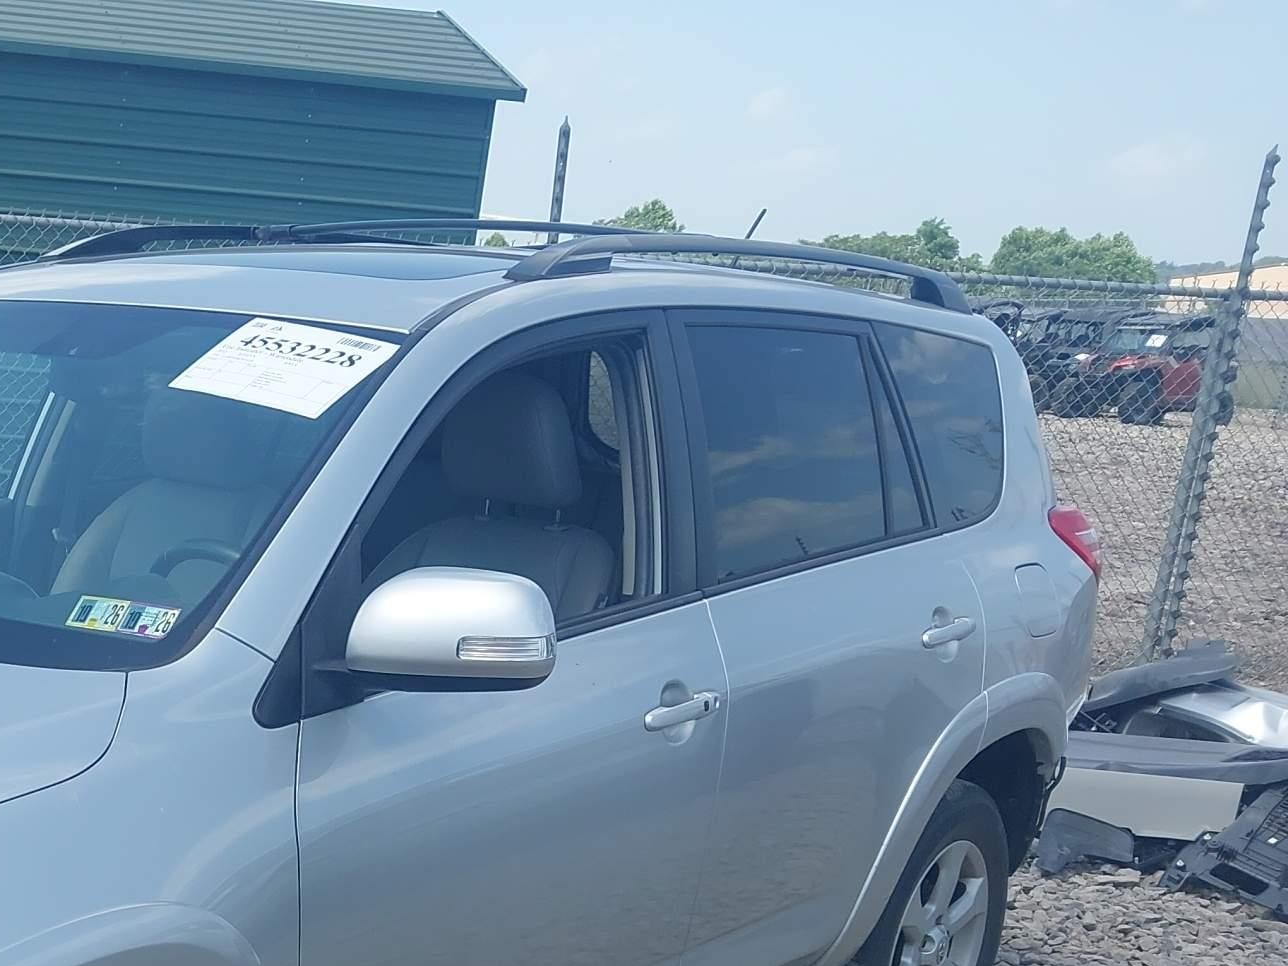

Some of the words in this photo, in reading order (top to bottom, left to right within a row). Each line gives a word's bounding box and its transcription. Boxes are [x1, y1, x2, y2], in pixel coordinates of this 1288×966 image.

[240, 334, 363, 368] 45532228
[103, 603, 125, 626] 26
[154, 611, 176, 634] 26
